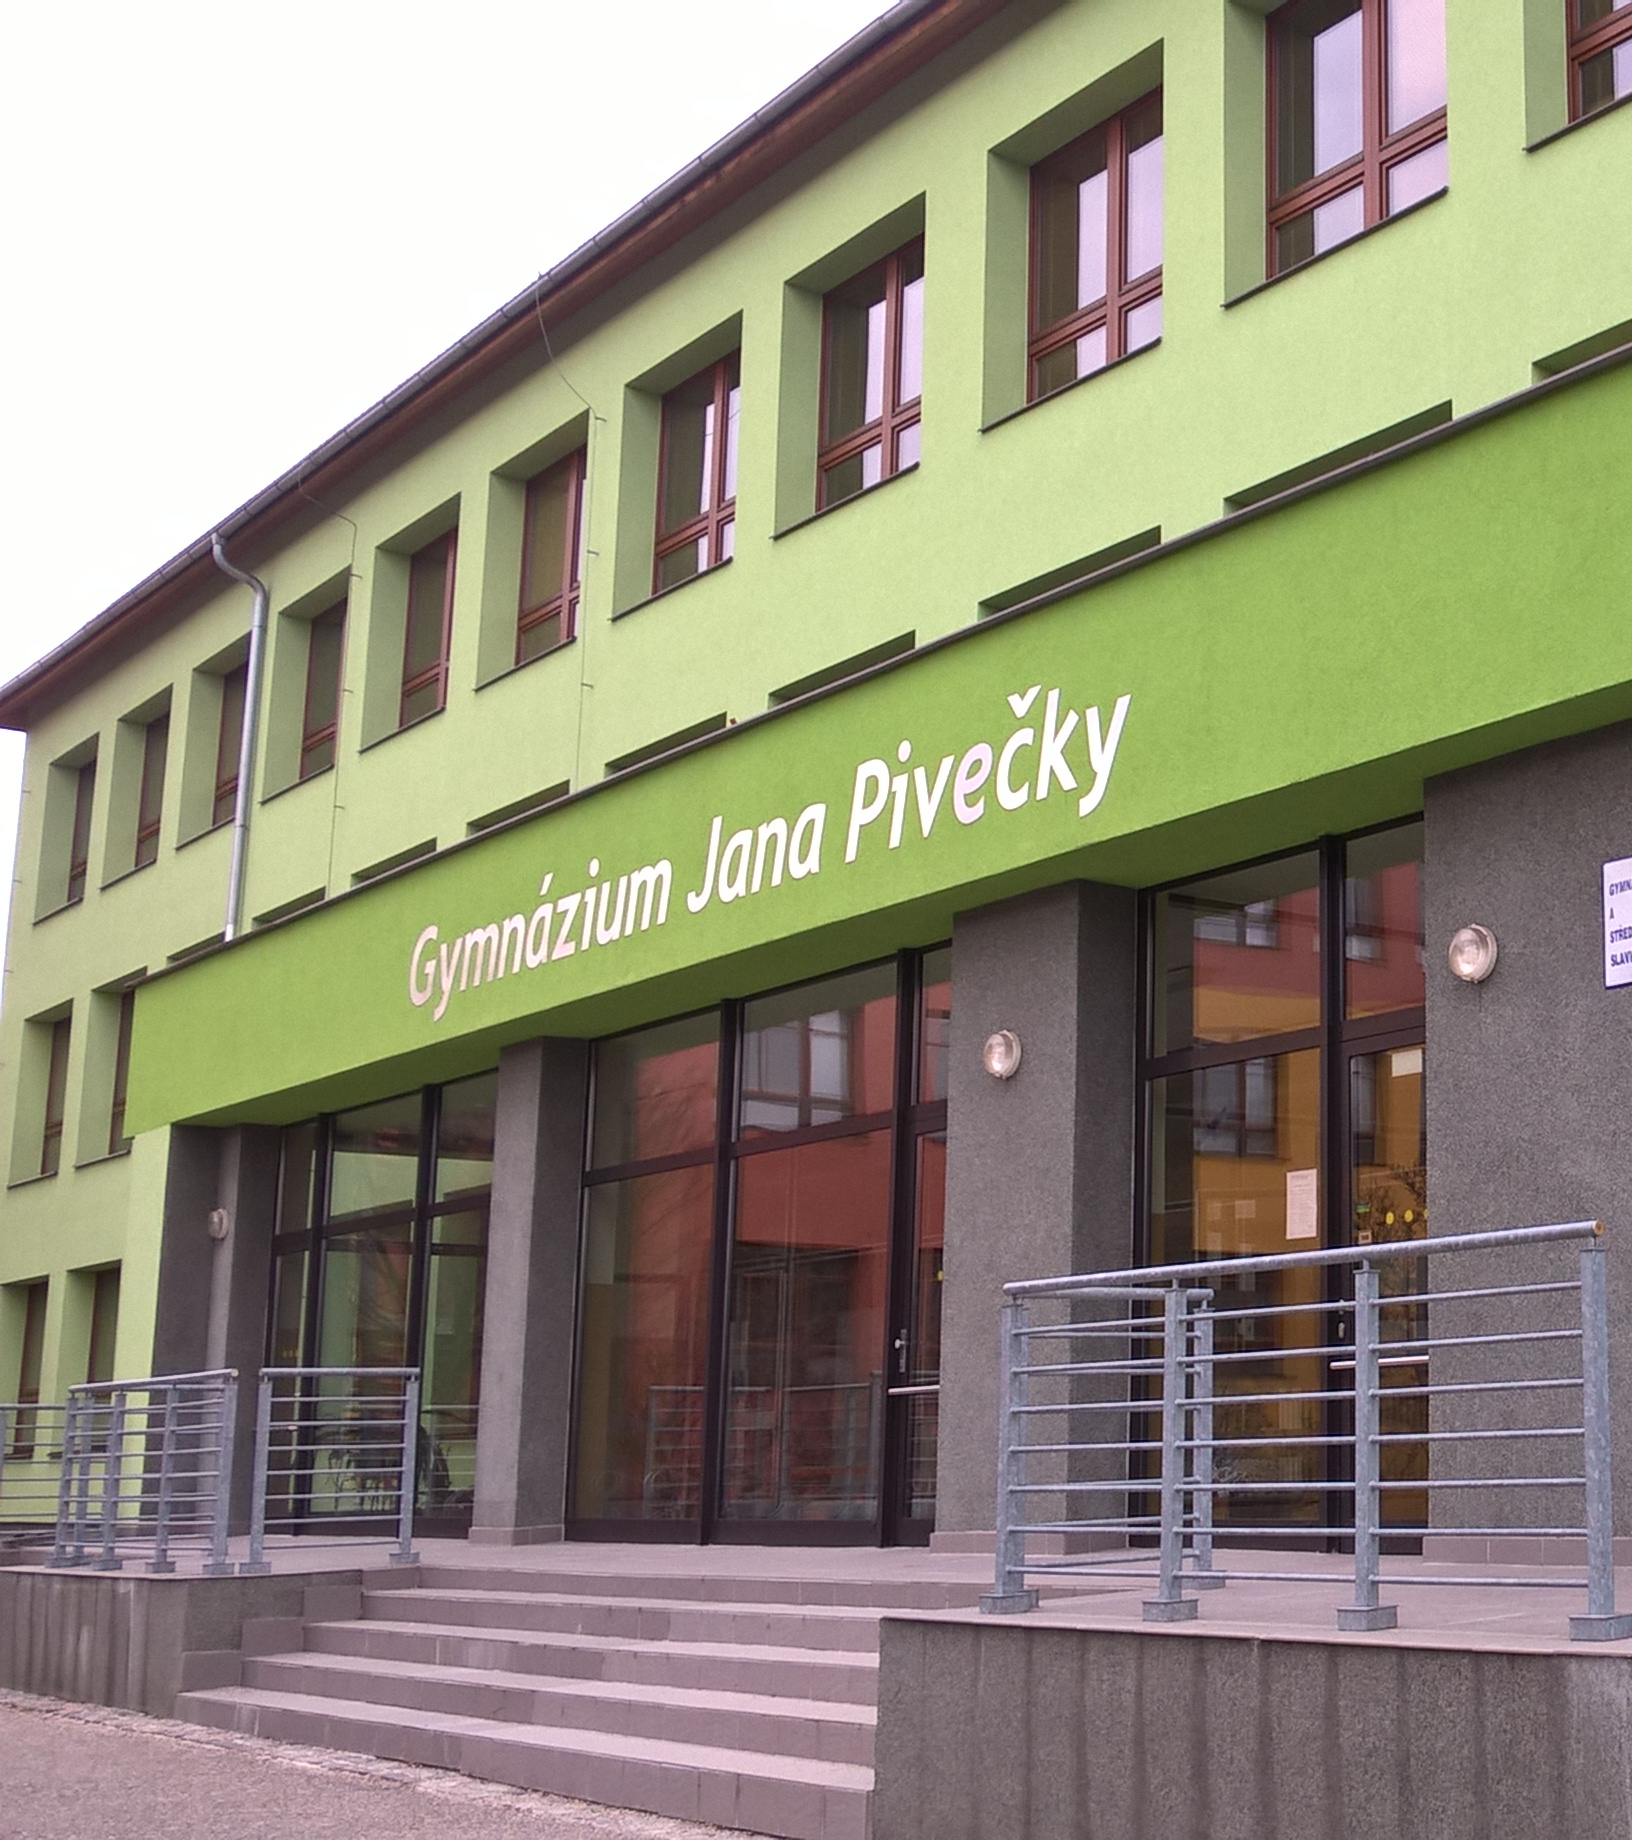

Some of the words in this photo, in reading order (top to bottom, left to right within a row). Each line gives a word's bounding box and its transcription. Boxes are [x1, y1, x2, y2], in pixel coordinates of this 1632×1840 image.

[408, 858, 673, 1022] Gymnázium
[686, 802, 828, 913] Jana
[843, 685, 1132, 863] Pivečky
[1609, 907, 1615, 920] A
